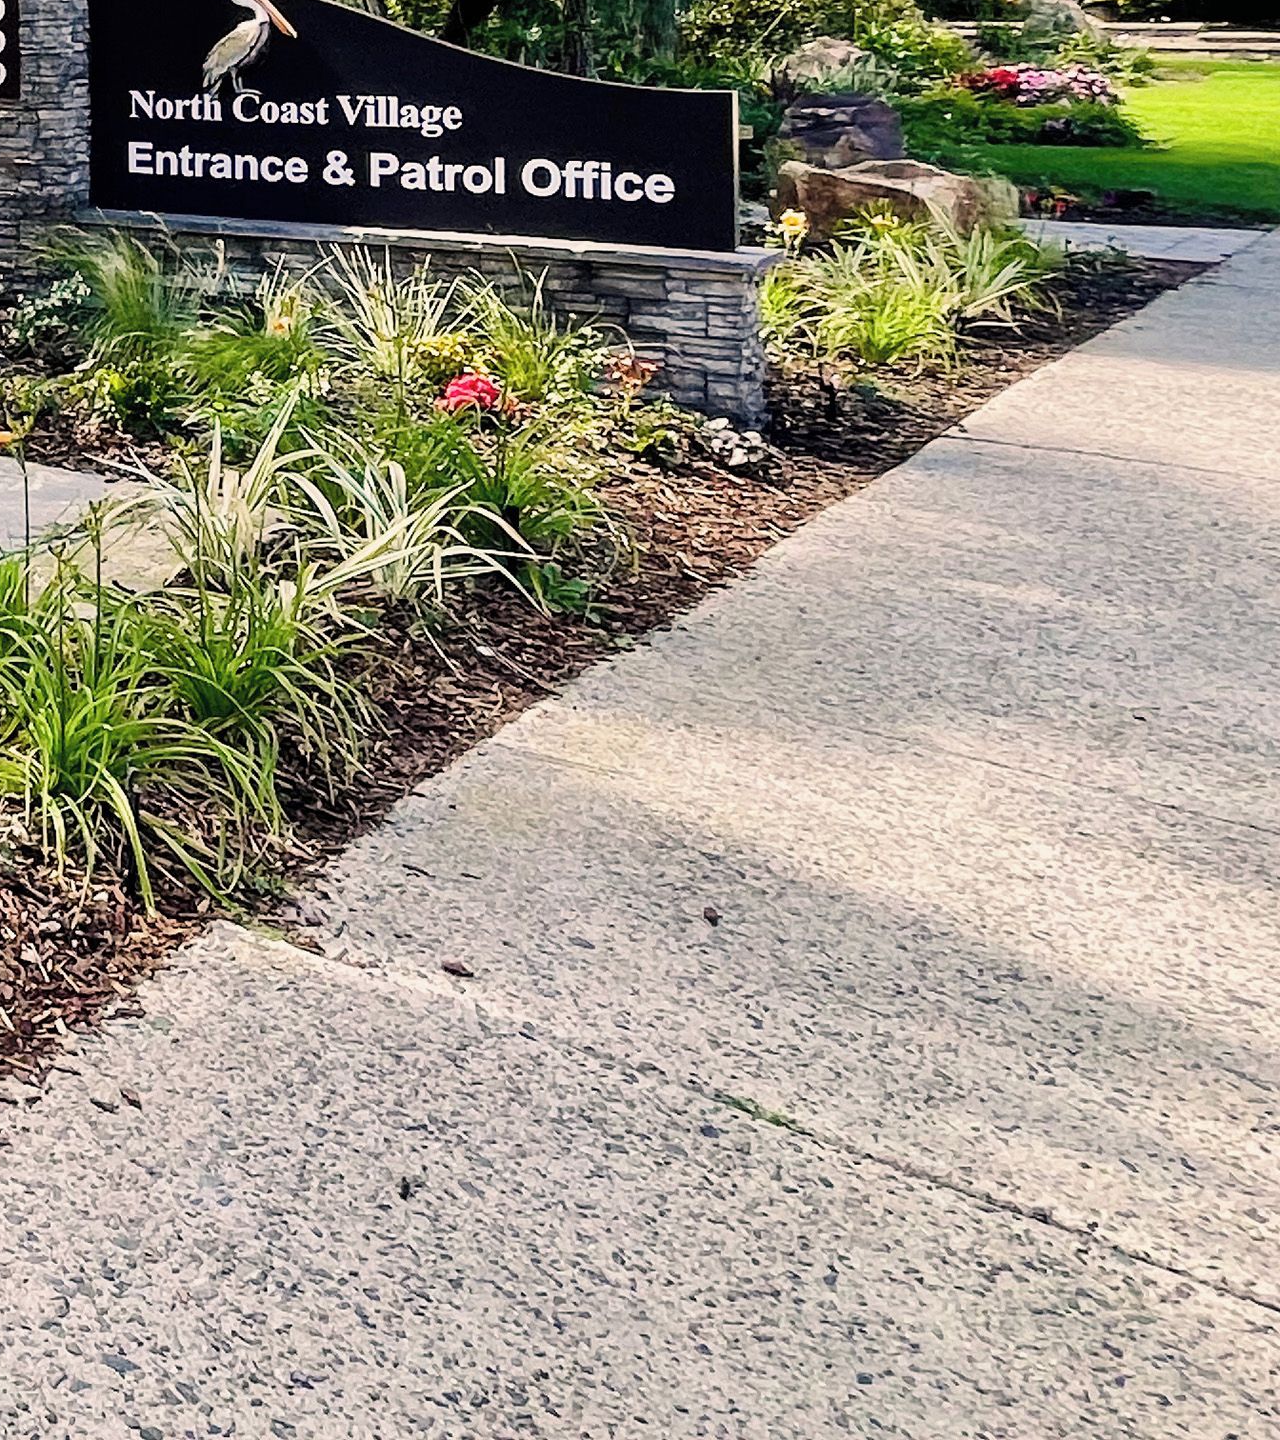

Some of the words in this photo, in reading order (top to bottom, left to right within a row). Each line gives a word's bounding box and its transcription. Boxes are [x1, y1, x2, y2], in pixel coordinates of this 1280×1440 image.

[128, 90, 222, 122] North
[232, 91, 329, 125] Coast
[338, 94, 462, 136] Village
[127, 141, 309, 184] Entrance
[322, 149, 356, 186] &
[369, 152, 506, 195] Patrol
[521, 158, 676, 203] Office
